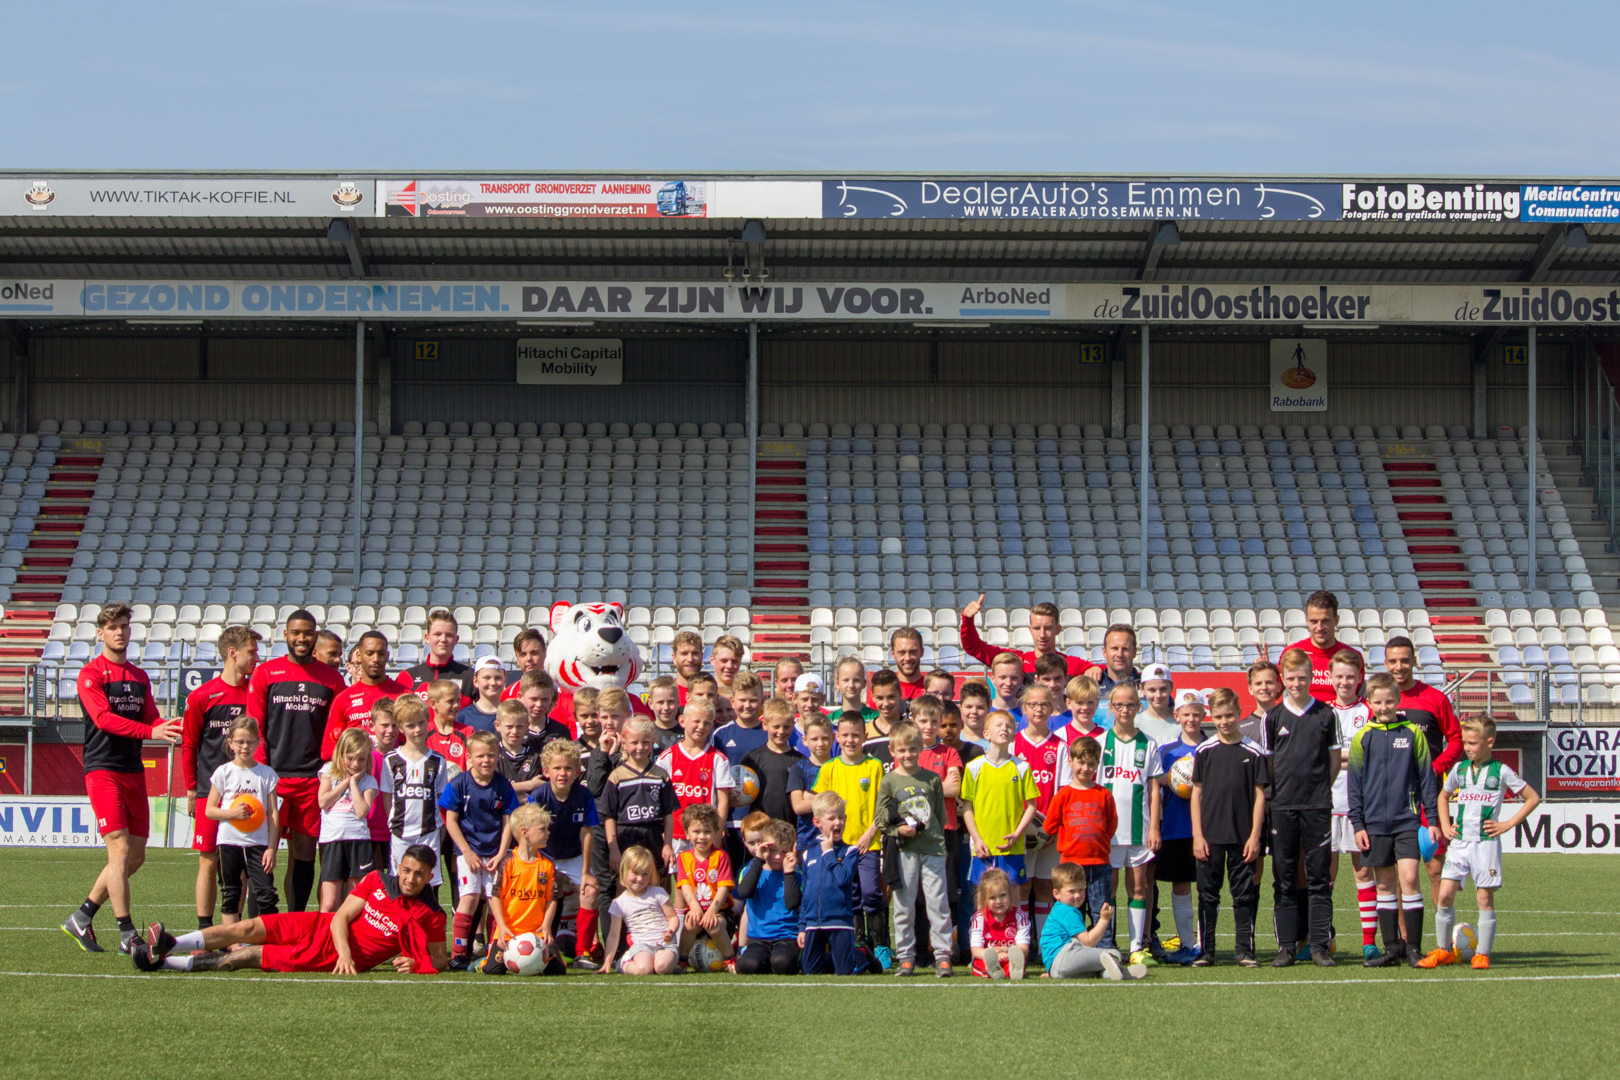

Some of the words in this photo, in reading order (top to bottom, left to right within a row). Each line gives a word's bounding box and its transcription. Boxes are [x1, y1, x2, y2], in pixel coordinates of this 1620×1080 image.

[480, 183, 530, 194] TRANSPORT
[535, 183, 596, 194] GRONDVERZET
[601, 184, 651, 195] AANNEMING
[921, 182, 1109, 205] DealerAuto's
[1128, 182, 1241, 205] Emmen
[90, 190, 296, 203] WWW.TIKTAK-KOFFIE.NL
[1342, 184, 1520, 218] FotoBenting
[485, 204, 648, 216] www.oostinggrondverzet.nl
[963, 206, 1200, 217] WWW.DEALERAUTOSEMMEN.NL
[1342, 210, 1389, 220] Fotografie
[1405, 210, 1446, 221] grafische
[1449, 211, 1502, 221] vormgeving
[1528, 204, 1619, 218] Communicatie
[80, 284, 230, 312] GEZOND
[242, 284, 509, 312] ONDERNEMEN.
[522, 286, 632, 313] DAAR
[645, 286, 724, 313] ZIJN
[739, 286, 804, 314] WIJ
[816, 287, 933, 315] VOOR.
[960, 287, 1050, 305] ArboNed
[417, 343, 436, 359] 12
[518, 346, 568, 360] Hitachi
[570, 346, 622, 361] Capital
[1083, 345, 1102, 362] 13
[1506, 347, 1525, 363] 14
[541, 362, 597, 377] Mobility
[1272, 397, 1326, 407] Rabobank
[298, 683, 305, 692] 2
[272, 695, 300, 704] Hitachi
[351, 698, 363, 707] 25
[230, 706, 242, 716] 27
[349, 711, 372, 722] Hitach
[1558, 778, 1620, 789] www.garantk
[397, 783, 432, 800] Jeep
[1460, 792, 1492, 803] essent
[463, 795, 471, 812] 7
